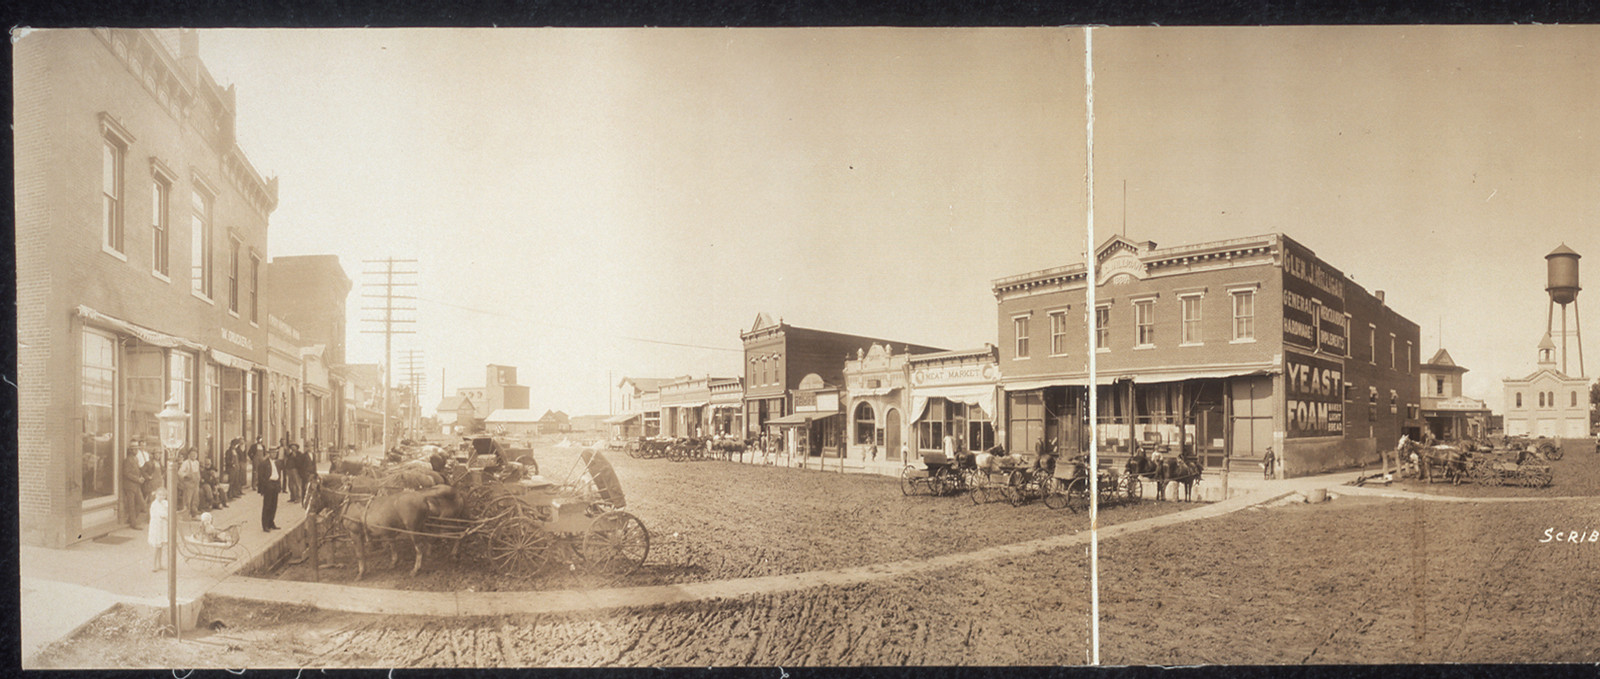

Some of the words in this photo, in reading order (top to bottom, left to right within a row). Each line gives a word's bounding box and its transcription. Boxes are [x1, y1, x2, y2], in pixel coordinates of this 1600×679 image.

[1284, 289, 1313, 315] GENERAL
[925, 372, 945, 380] MEAT
[947, 368, 979, 379] MARKET
[1287, 361, 1341, 397] YEAST
[1287, 400, 1328, 431] FOAM
